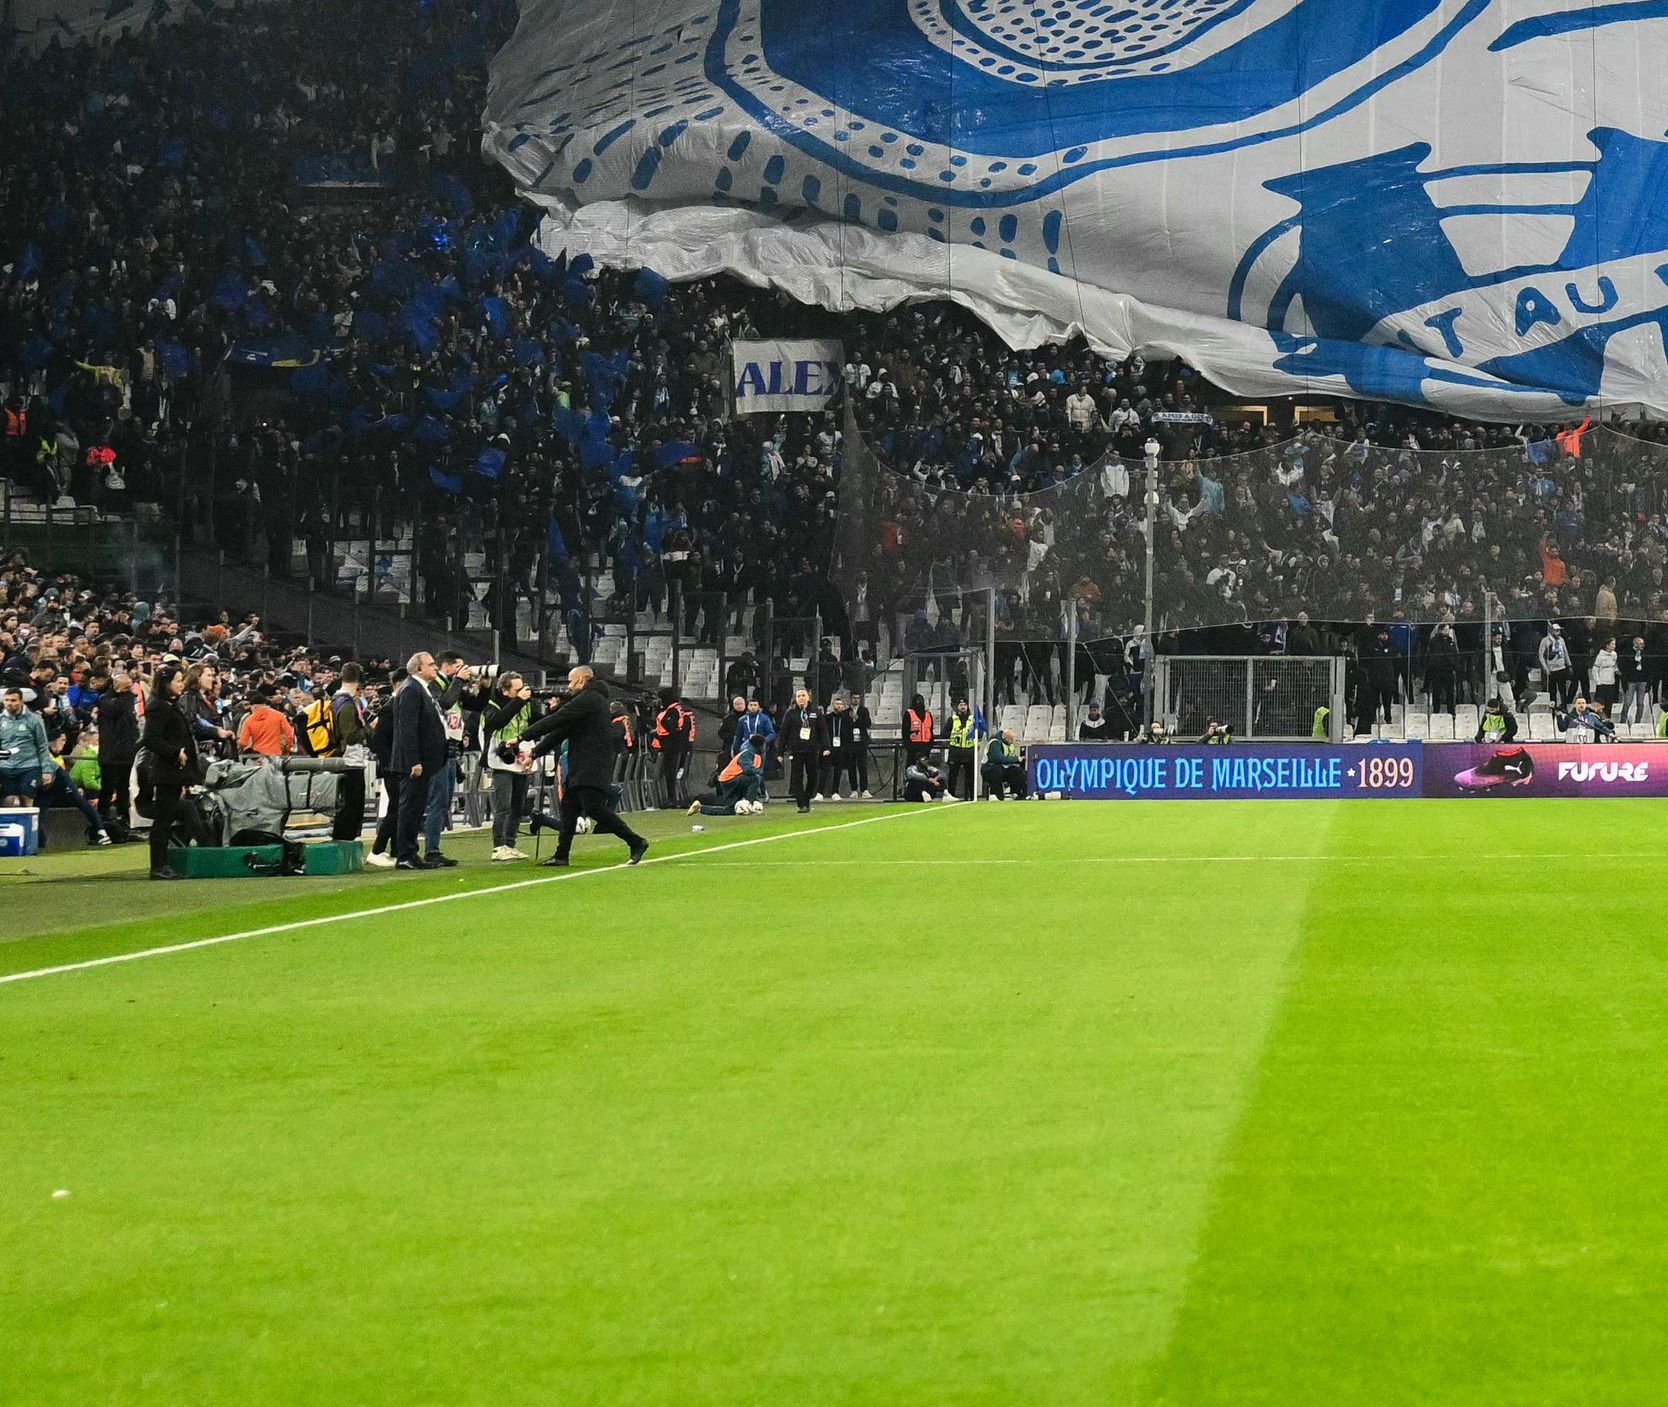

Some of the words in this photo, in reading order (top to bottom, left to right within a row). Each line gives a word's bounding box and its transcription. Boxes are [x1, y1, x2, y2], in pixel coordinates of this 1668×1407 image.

[1516, 276, 1618, 337] AU
[1036, 757, 1168, 794] OLYMPIQUE
[1175, 758, 1203, 789] DE
[1211, 757, 1342, 792] MARSEILLE
[1358, 757, 1414, 789] 1899
[1558, 761, 1649, 782] FUTURE
